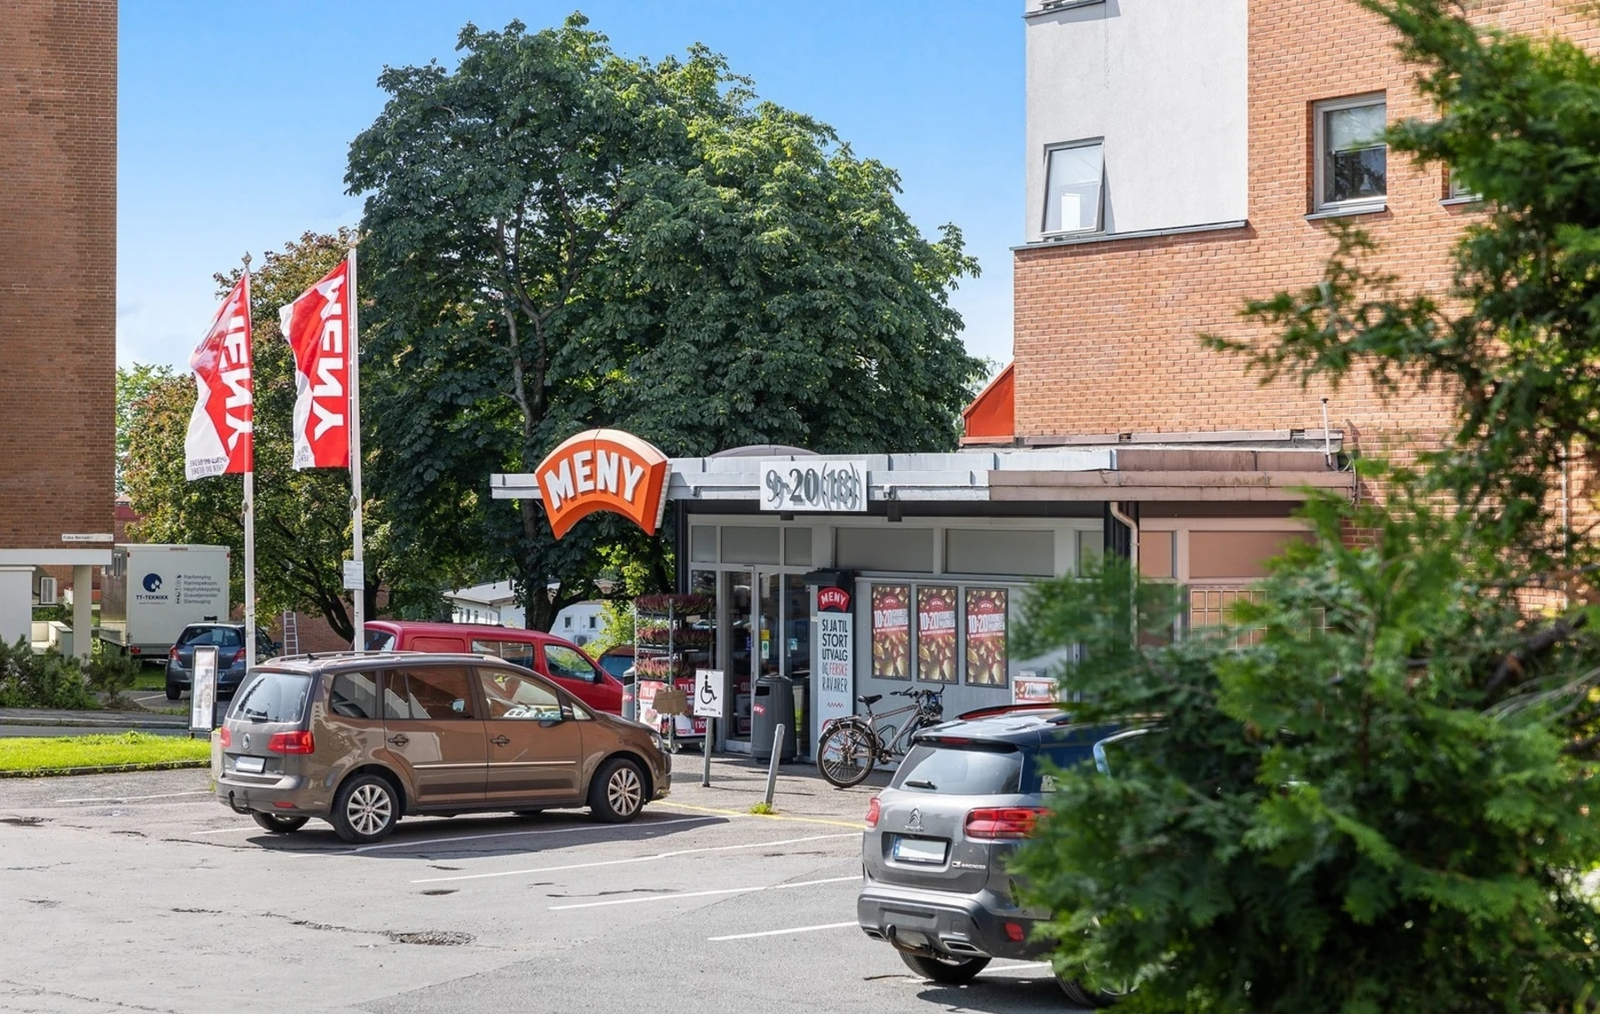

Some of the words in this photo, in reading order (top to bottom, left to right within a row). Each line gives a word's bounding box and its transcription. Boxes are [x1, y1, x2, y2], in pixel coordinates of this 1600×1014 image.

[544, 449, 644, 511] MENY
[820, 591, 846, 606] MENY
[822, 619, 828, 632] SI
[829, 619, 837, 632] JA
[838, 620, 848, 633] TIL
[822, 633, 848, 648] STORT
[822, 648, 848, 662] UTVALG
[829, 663, 848, 677] FERSKE
[679, 683, 695, 693] TILB
